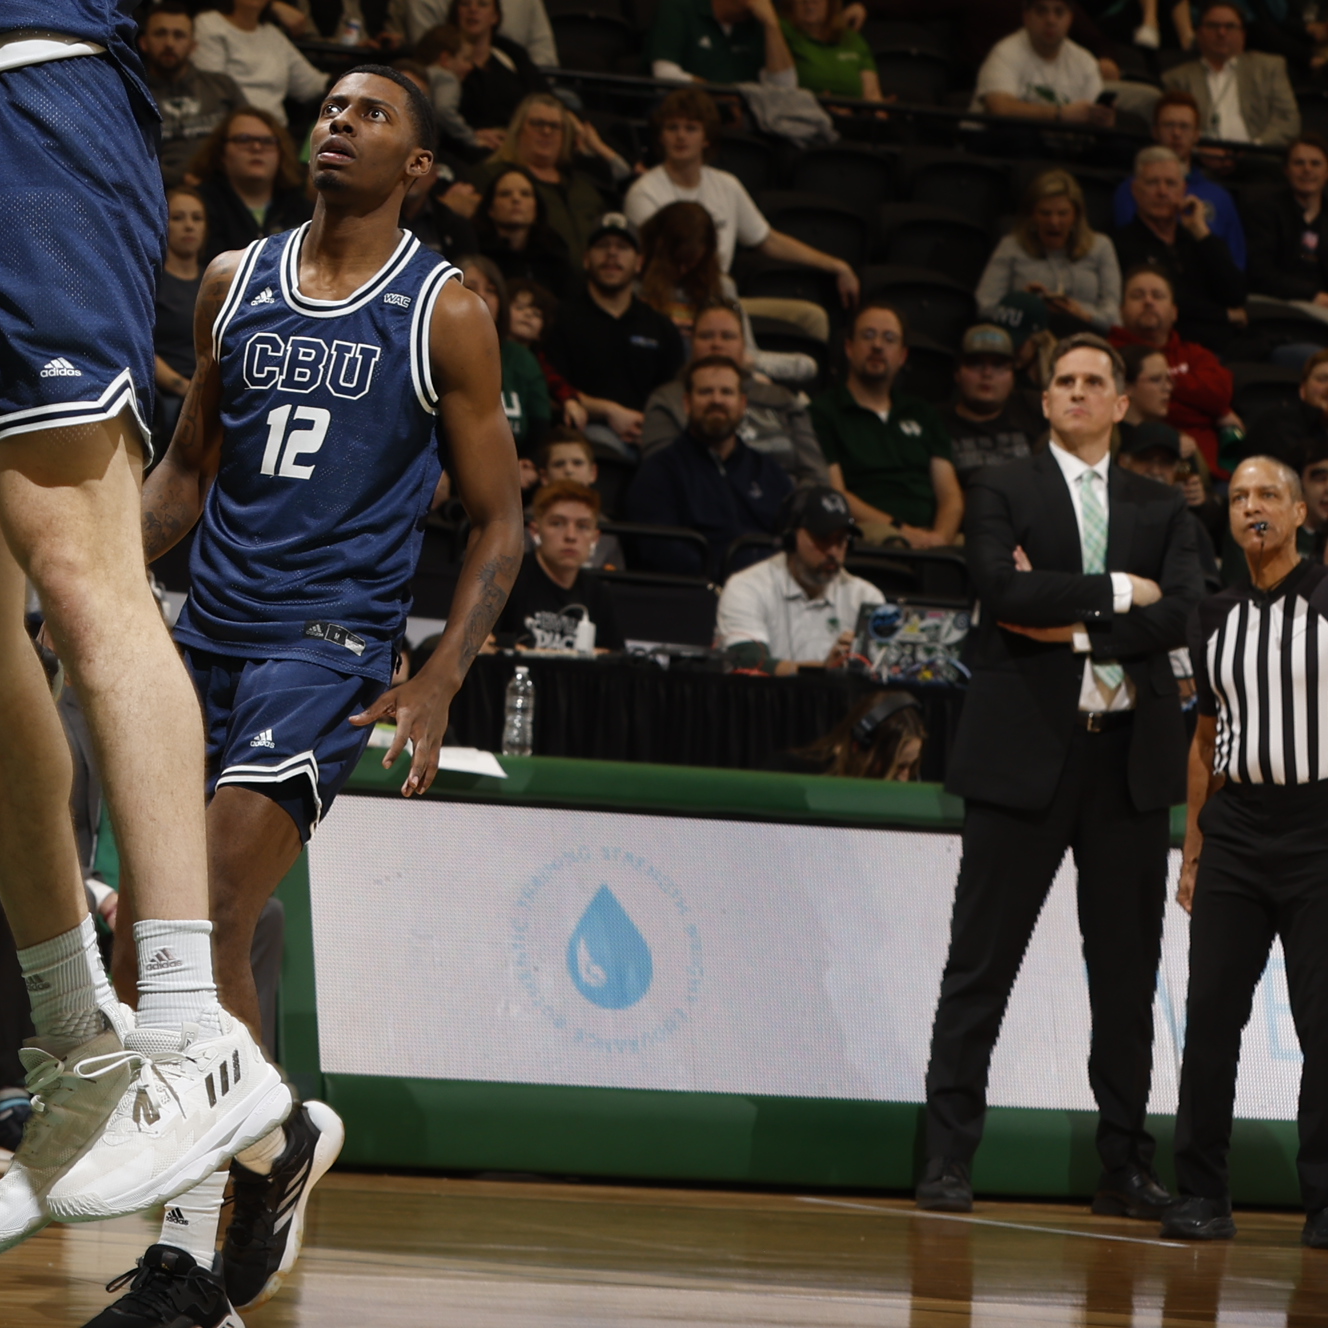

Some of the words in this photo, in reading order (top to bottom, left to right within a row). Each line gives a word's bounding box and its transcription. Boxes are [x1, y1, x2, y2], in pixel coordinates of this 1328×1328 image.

[383, 293, 412, 308] WAC
[40, 368, 82, 378] adidas
[244, 332, 381, 400] CBU
[260, 404, 331, 480] 12
[146, 959, 183, 971] adidas
